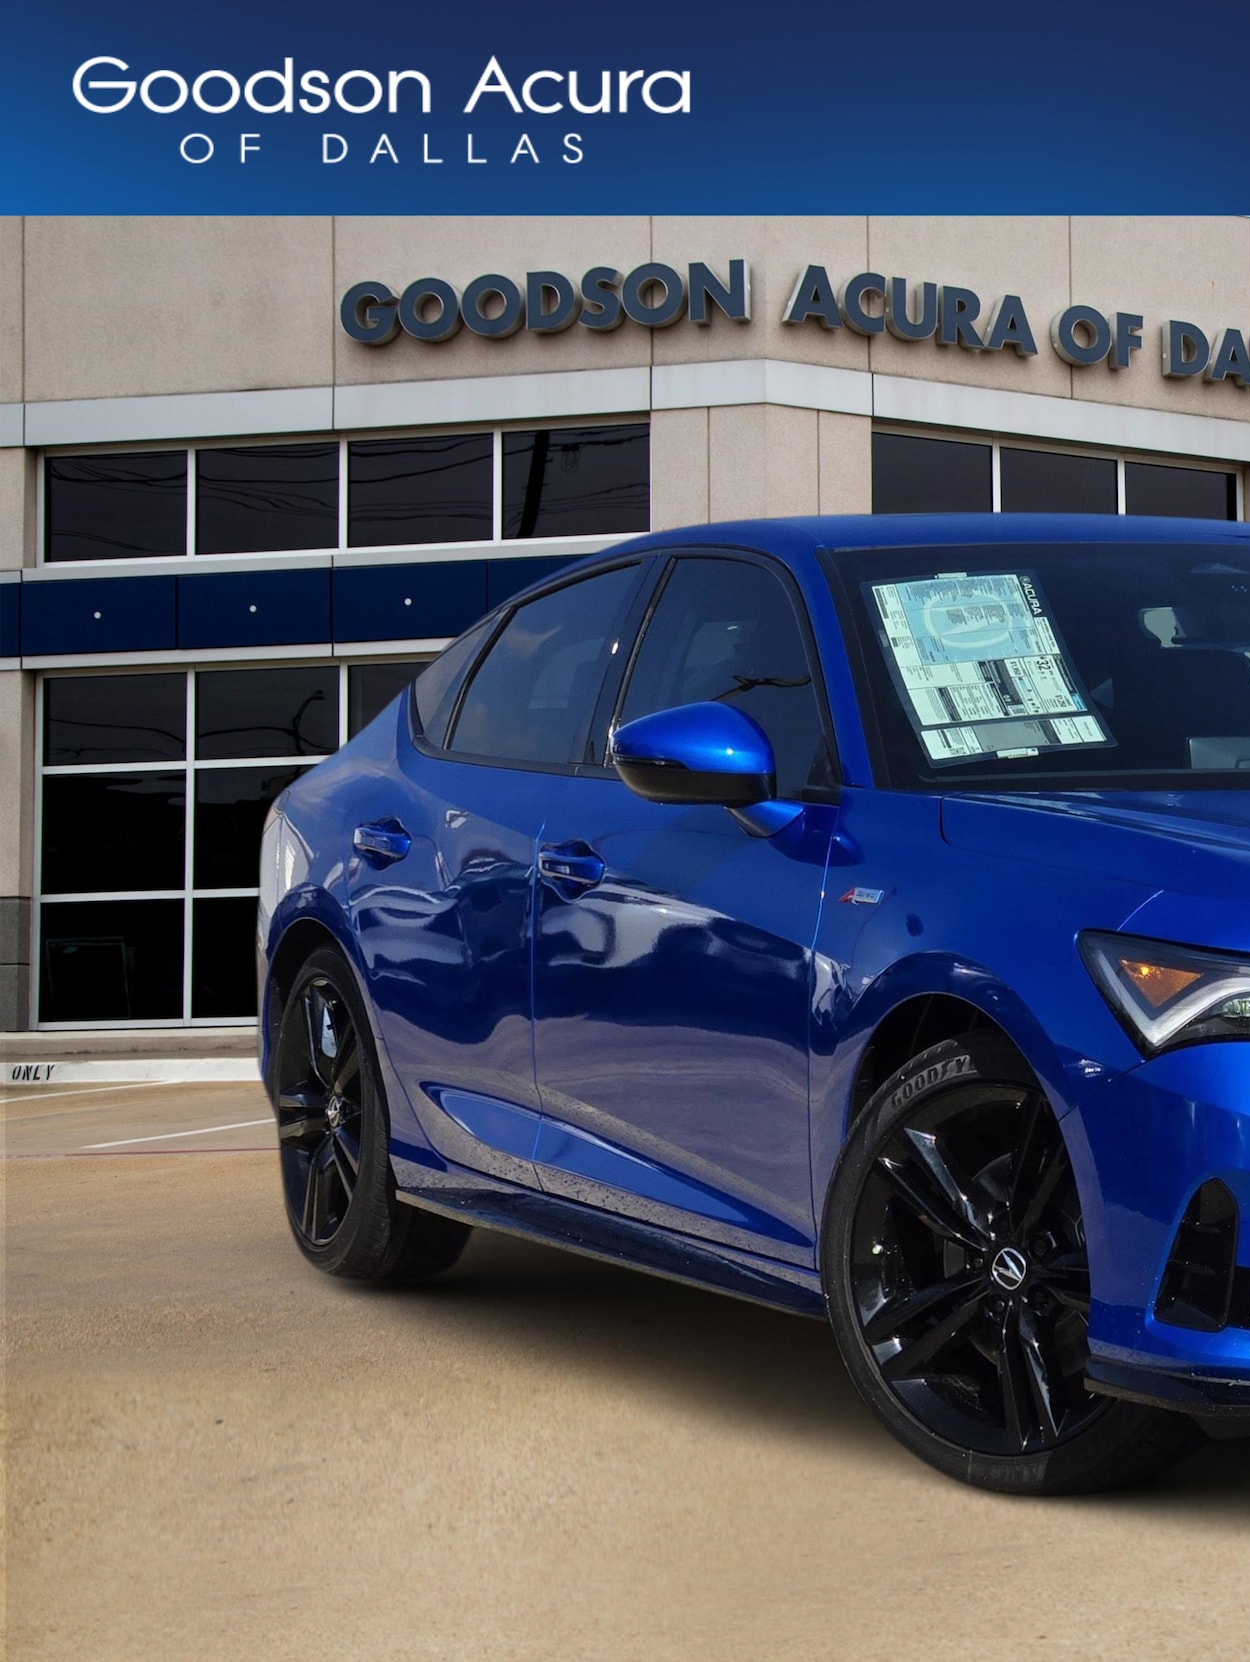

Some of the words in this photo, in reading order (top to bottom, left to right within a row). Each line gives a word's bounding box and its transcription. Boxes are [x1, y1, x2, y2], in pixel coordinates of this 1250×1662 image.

[340, 259, 752, 347] GOODSON
[782, 264, 1038, 357] ACURA
[1051, 305, 1143, 368] OF
[1021, 582, 1042, 615] ACURA
[11, 1064, 56, 1081] ONLY
[889, 1055, 971, 1110] GOODY
